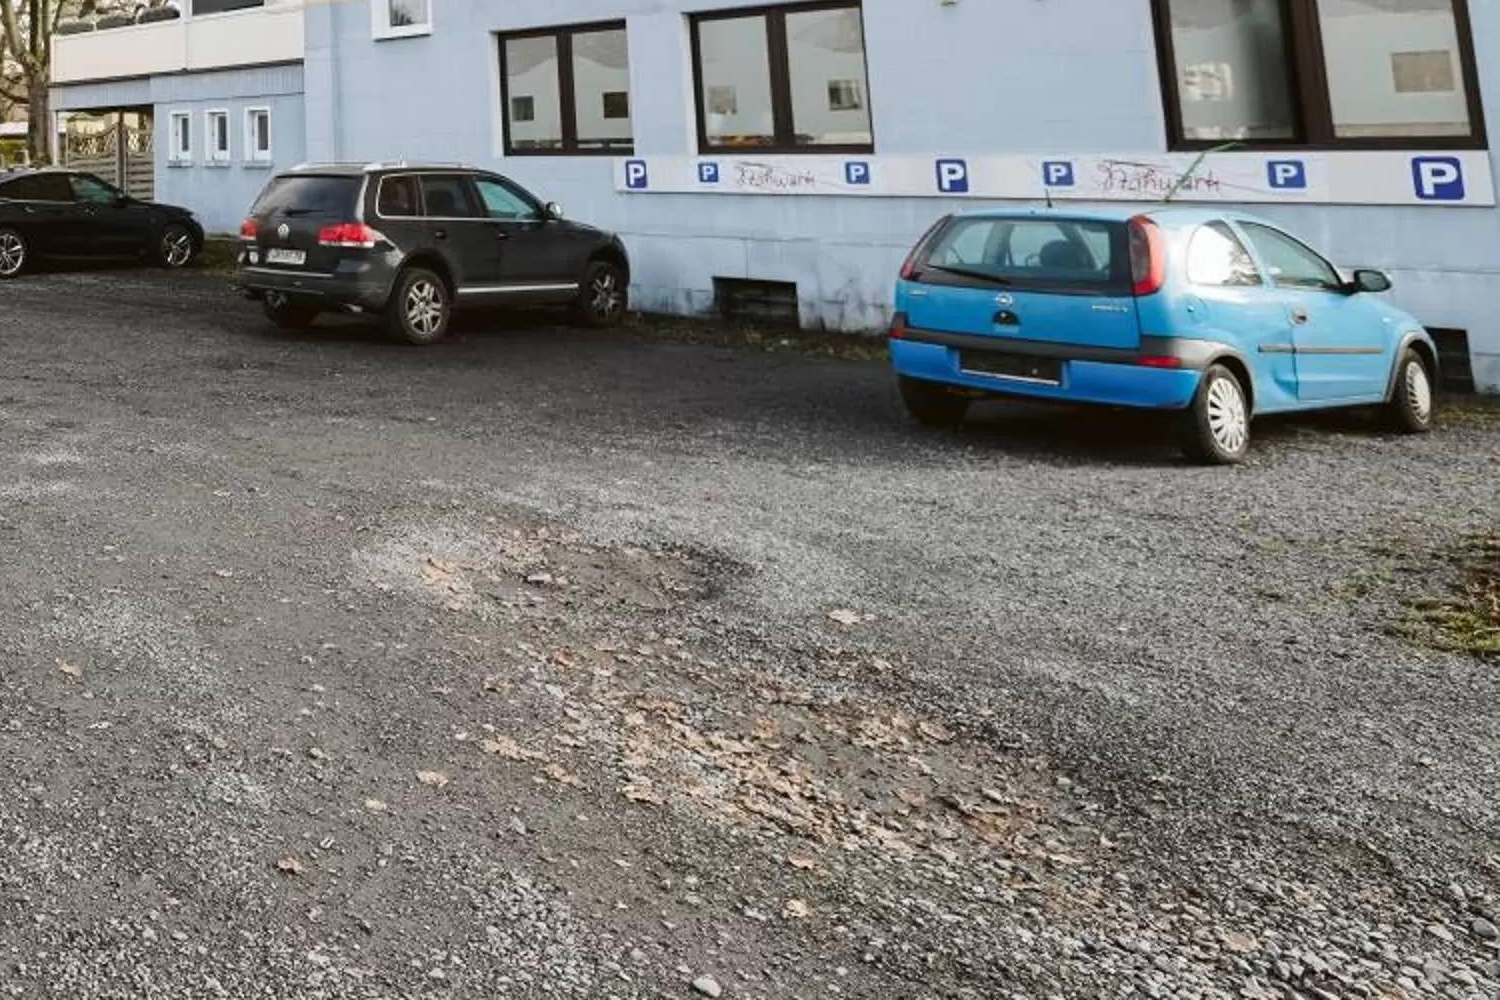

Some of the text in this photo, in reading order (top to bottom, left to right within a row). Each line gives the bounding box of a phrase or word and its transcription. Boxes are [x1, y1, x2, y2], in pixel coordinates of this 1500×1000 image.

[628, 164, 645, 186] P
[702, 165, 715, 181] P
[849, 165, 865, 182] P
[940, 163, 964, 190] P
[1049, 164, 1067, 183] P
[1274, 163, 1298, 185] P
[1419, 161, 1458, 195] P
